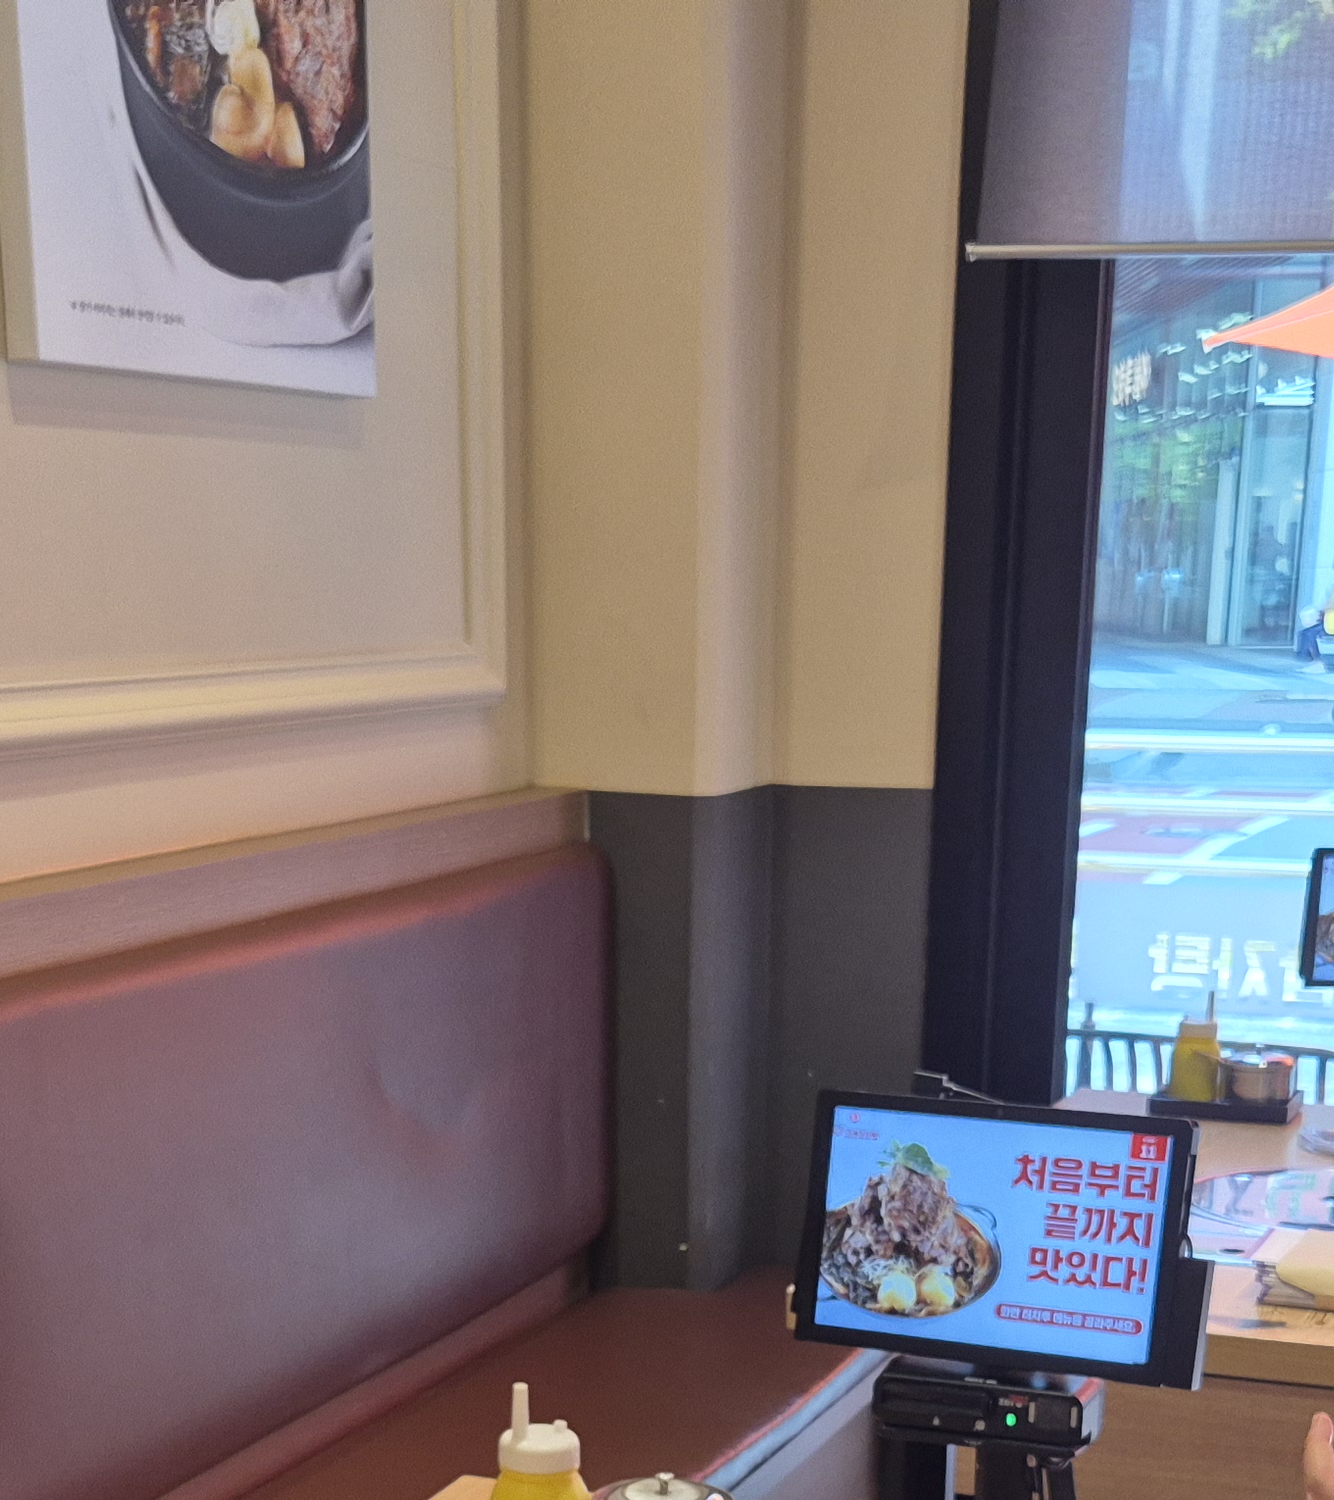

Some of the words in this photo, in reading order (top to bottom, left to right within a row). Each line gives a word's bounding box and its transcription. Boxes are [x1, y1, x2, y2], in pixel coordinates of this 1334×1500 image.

[1011, 1152, 1160, 1203] 처음부터
[1043, 1202, 1154, 1248] 끝까지
[1027, 1246, 1149, 1295] 맛있다!
